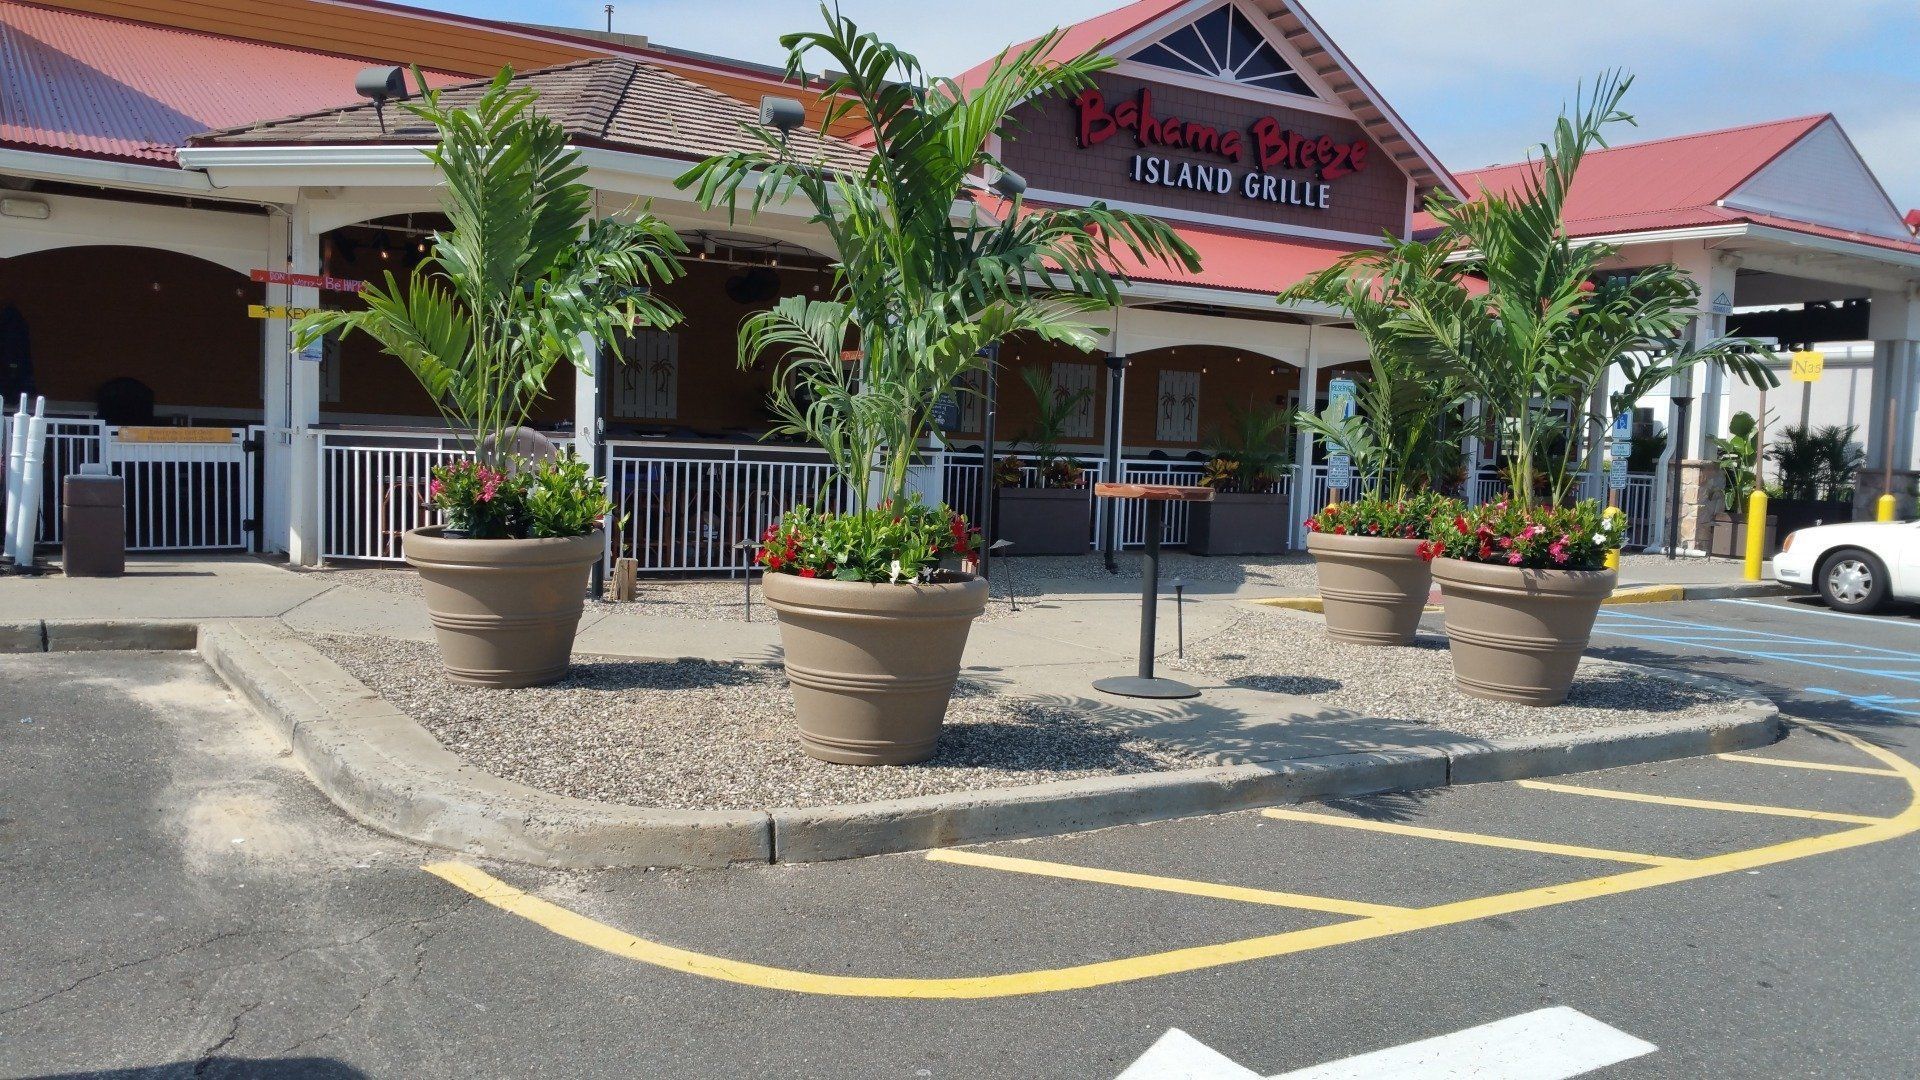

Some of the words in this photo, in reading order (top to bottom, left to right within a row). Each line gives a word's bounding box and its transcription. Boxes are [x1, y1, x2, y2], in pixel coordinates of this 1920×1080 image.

[1072, 87, 1242, 162] Bahama
[1249, 115, 1369, 180] Breeze
[1134, 154, 1233, 195] ISLAND
[1244, 172, 1331, 209] GRILLE
[325, 275, 341, 290] Be
[285, 306, 310, 320] KEY
[1793, 360, 1822, 375] N35
